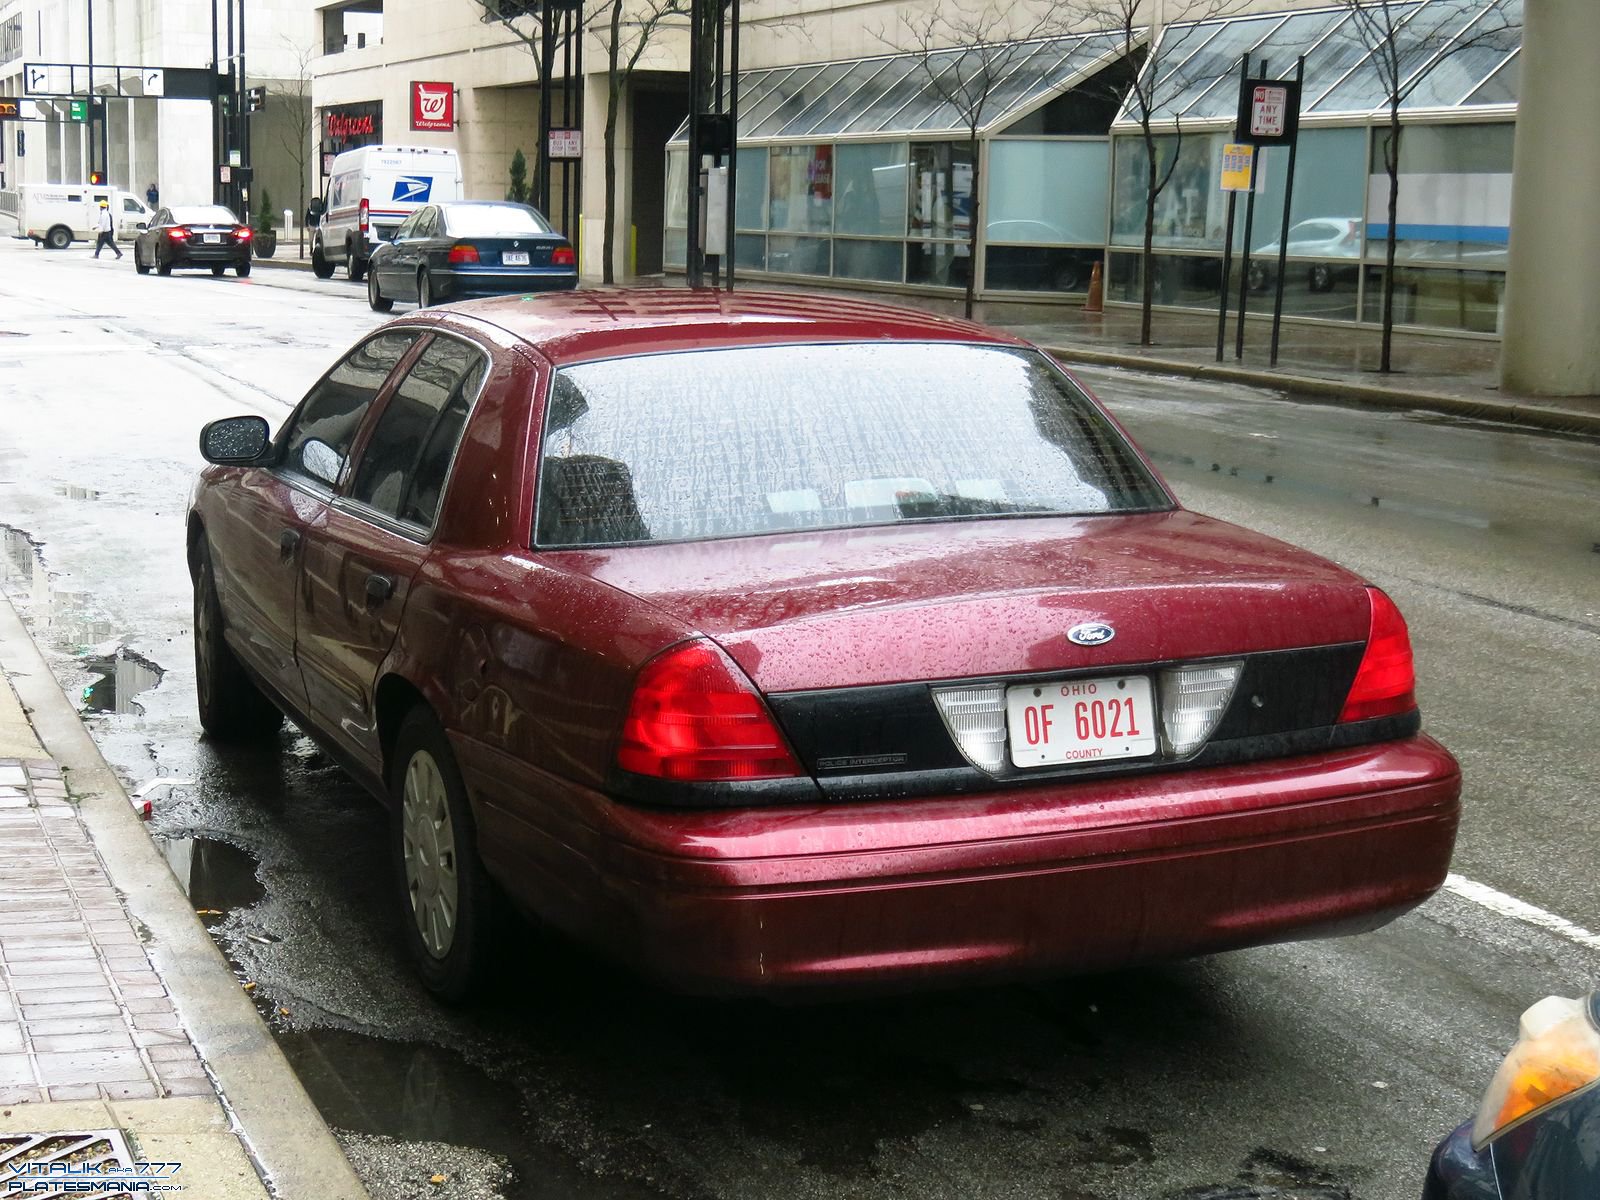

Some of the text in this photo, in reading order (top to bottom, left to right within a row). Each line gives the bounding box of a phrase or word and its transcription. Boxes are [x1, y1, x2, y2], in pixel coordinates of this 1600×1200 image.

[1255, 91, 1265, 100] NO
[1260, 105, 1278, 114] ANY
[415, 120, 451, 129] Walgreens
[1258, 116, 1278, 125] TIME
[327, 113, 374, 144] Walgreens
[1078, 629, 1105, 641] Ford
[1060, 683, 1097, 697] OHIO
[1024, 697, 1140, 745] OF 6021
[1065, 748, 1104, 760] COUNTY
[820, 755, 905, 767] POLICE INTERCEPTOR
